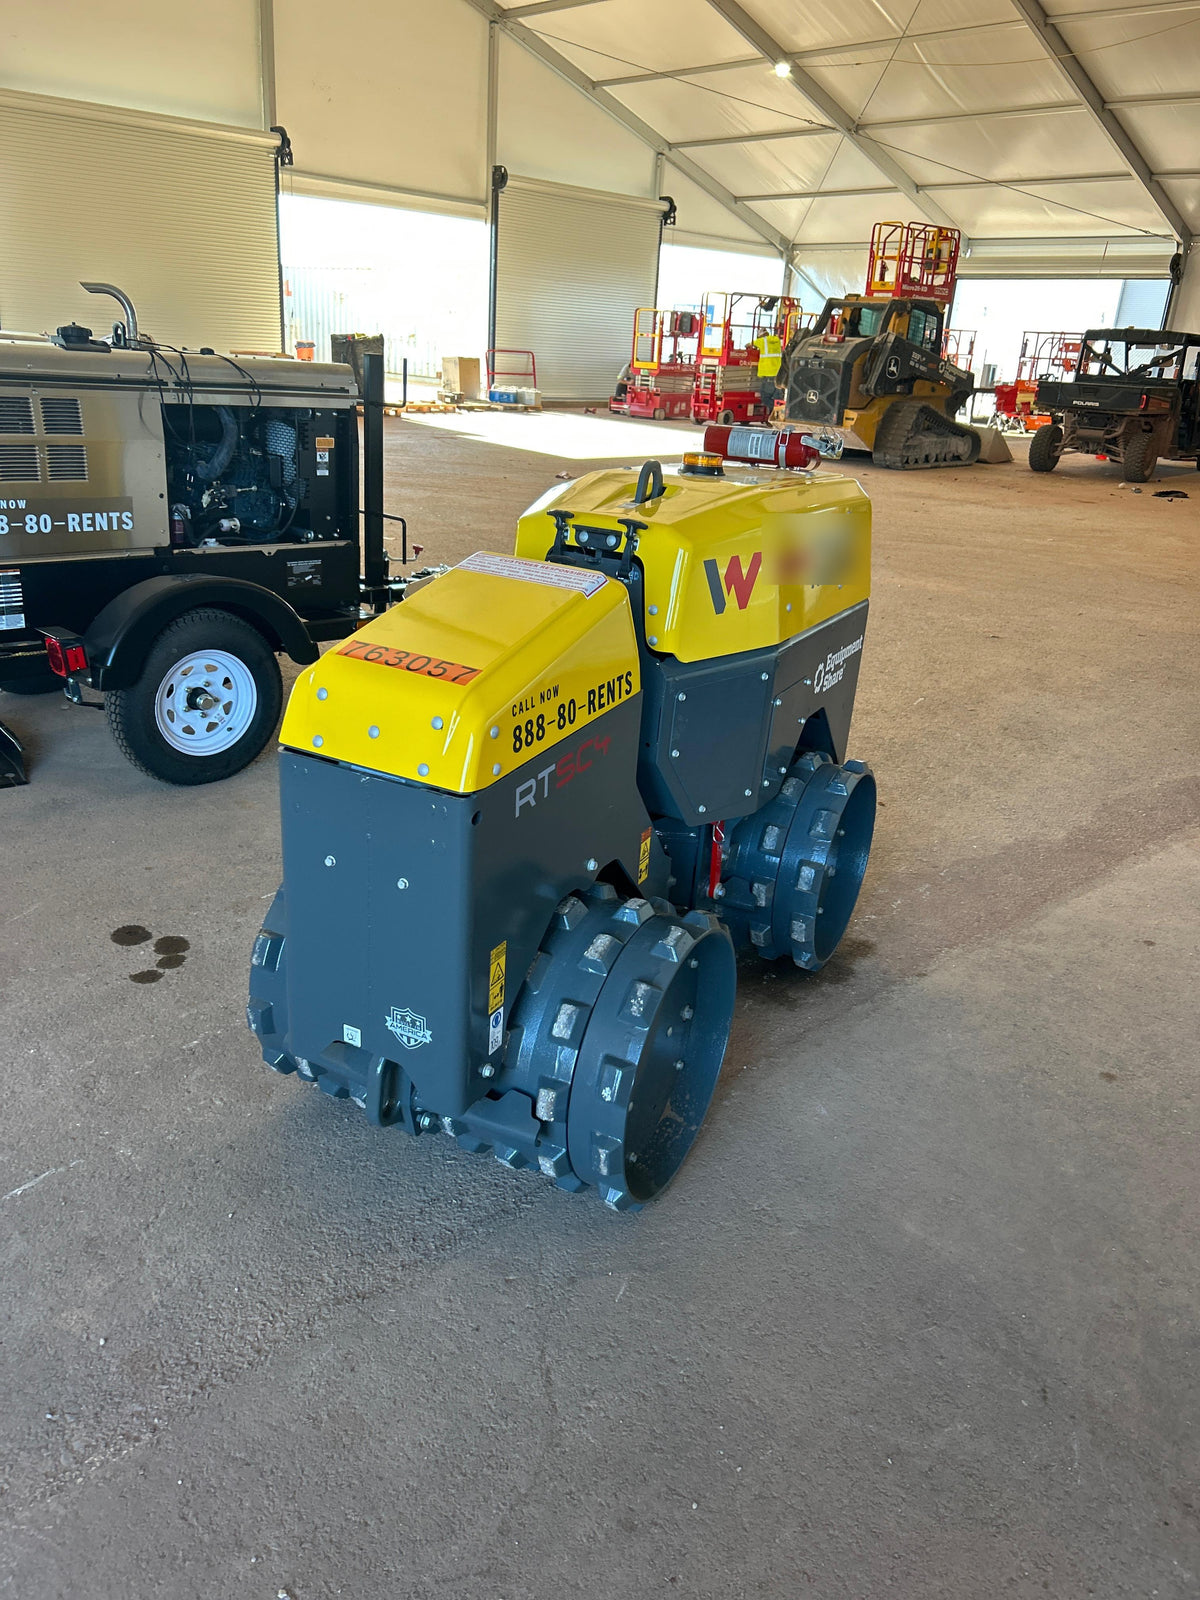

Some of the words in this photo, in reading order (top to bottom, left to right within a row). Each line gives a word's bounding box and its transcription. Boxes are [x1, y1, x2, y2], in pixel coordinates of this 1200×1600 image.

[0, 499, 26, 509] NOW
[499, 557, 539, 569] CUSTOMER
[540, 563, 602, 579] RESPONSIBILITY
[344, 640, 478, 682] 763057
[826, 634, 863, 672] Equipment
[823, 668, 844, 692] Share
[511, 697, 536, 717] CALL
[540, 684, 560, 704] NOW
[512, 670, 633, 753] 888-80-RENTS
[389, 1021, 428, 1041] AMERICA
